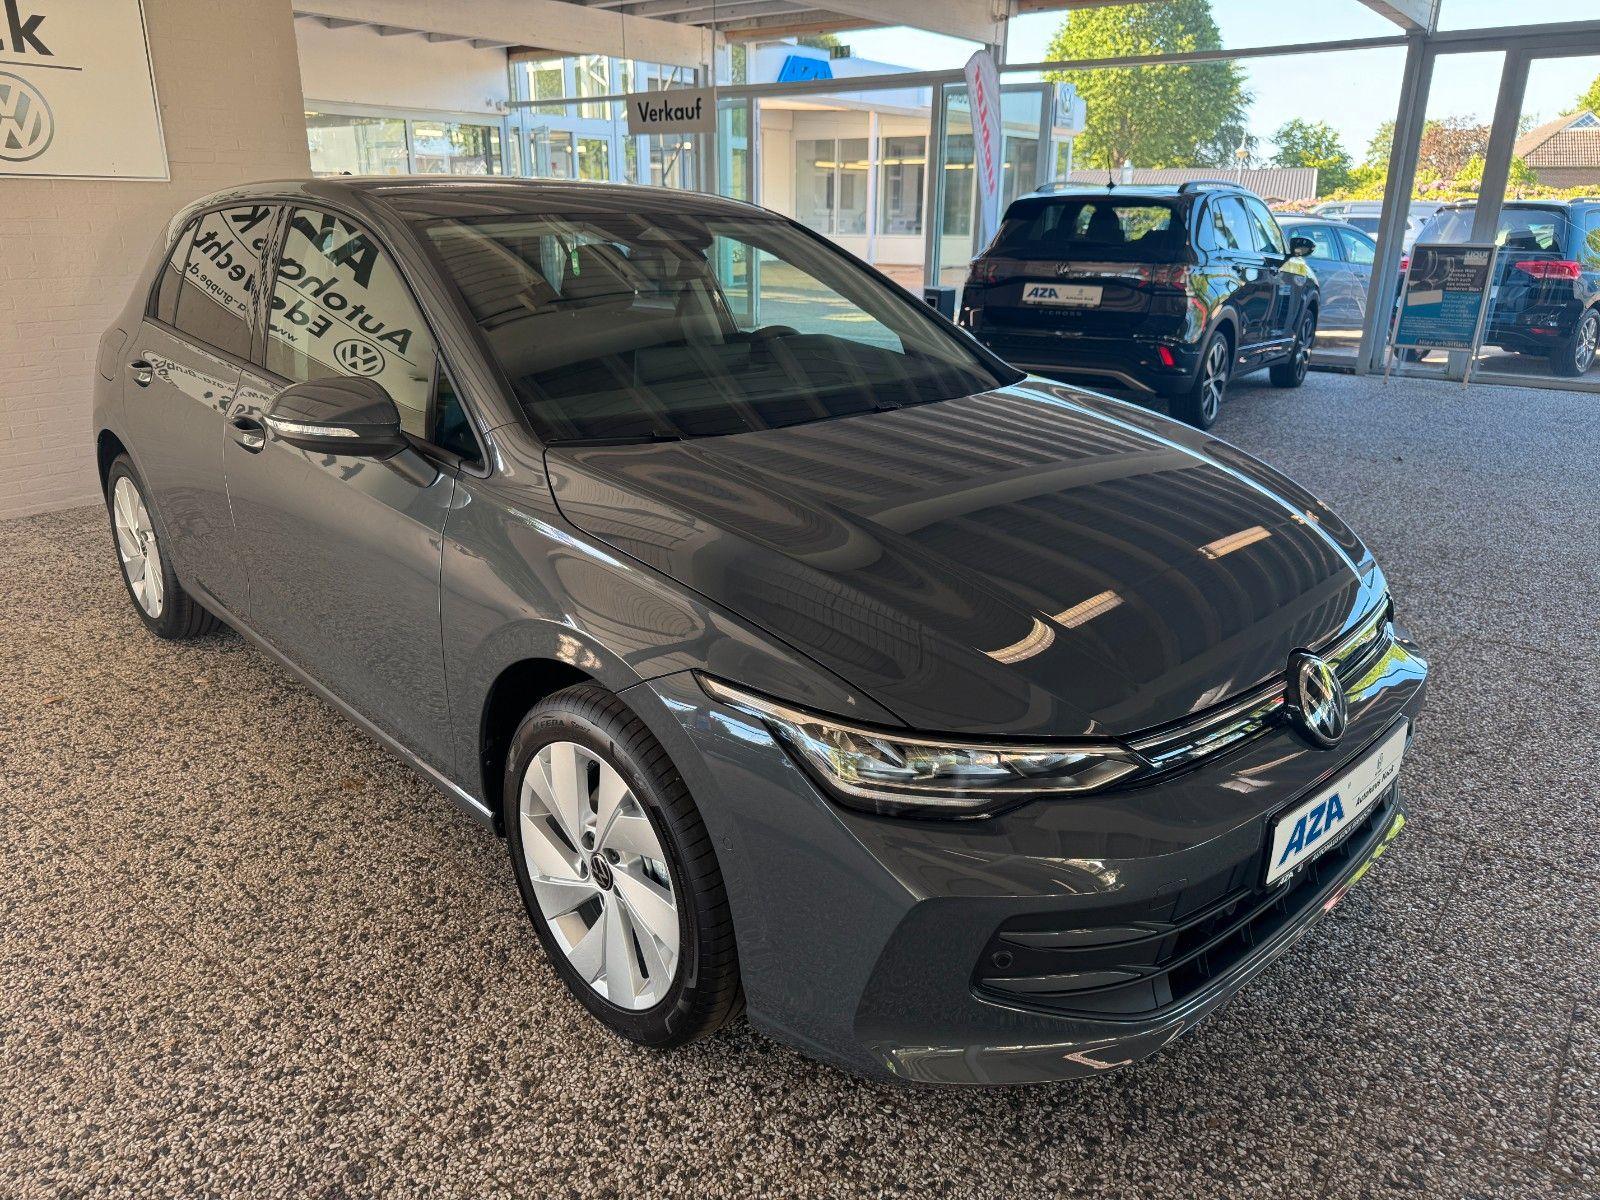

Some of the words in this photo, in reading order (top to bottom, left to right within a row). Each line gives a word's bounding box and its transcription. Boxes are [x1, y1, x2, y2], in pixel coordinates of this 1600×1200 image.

[0, 0, 54, 56] k
[637, 97, 702, 122] Verkauf
[1027, 287, 1059, 299] AZA
[1275, 791, 1345, 870] AZA
